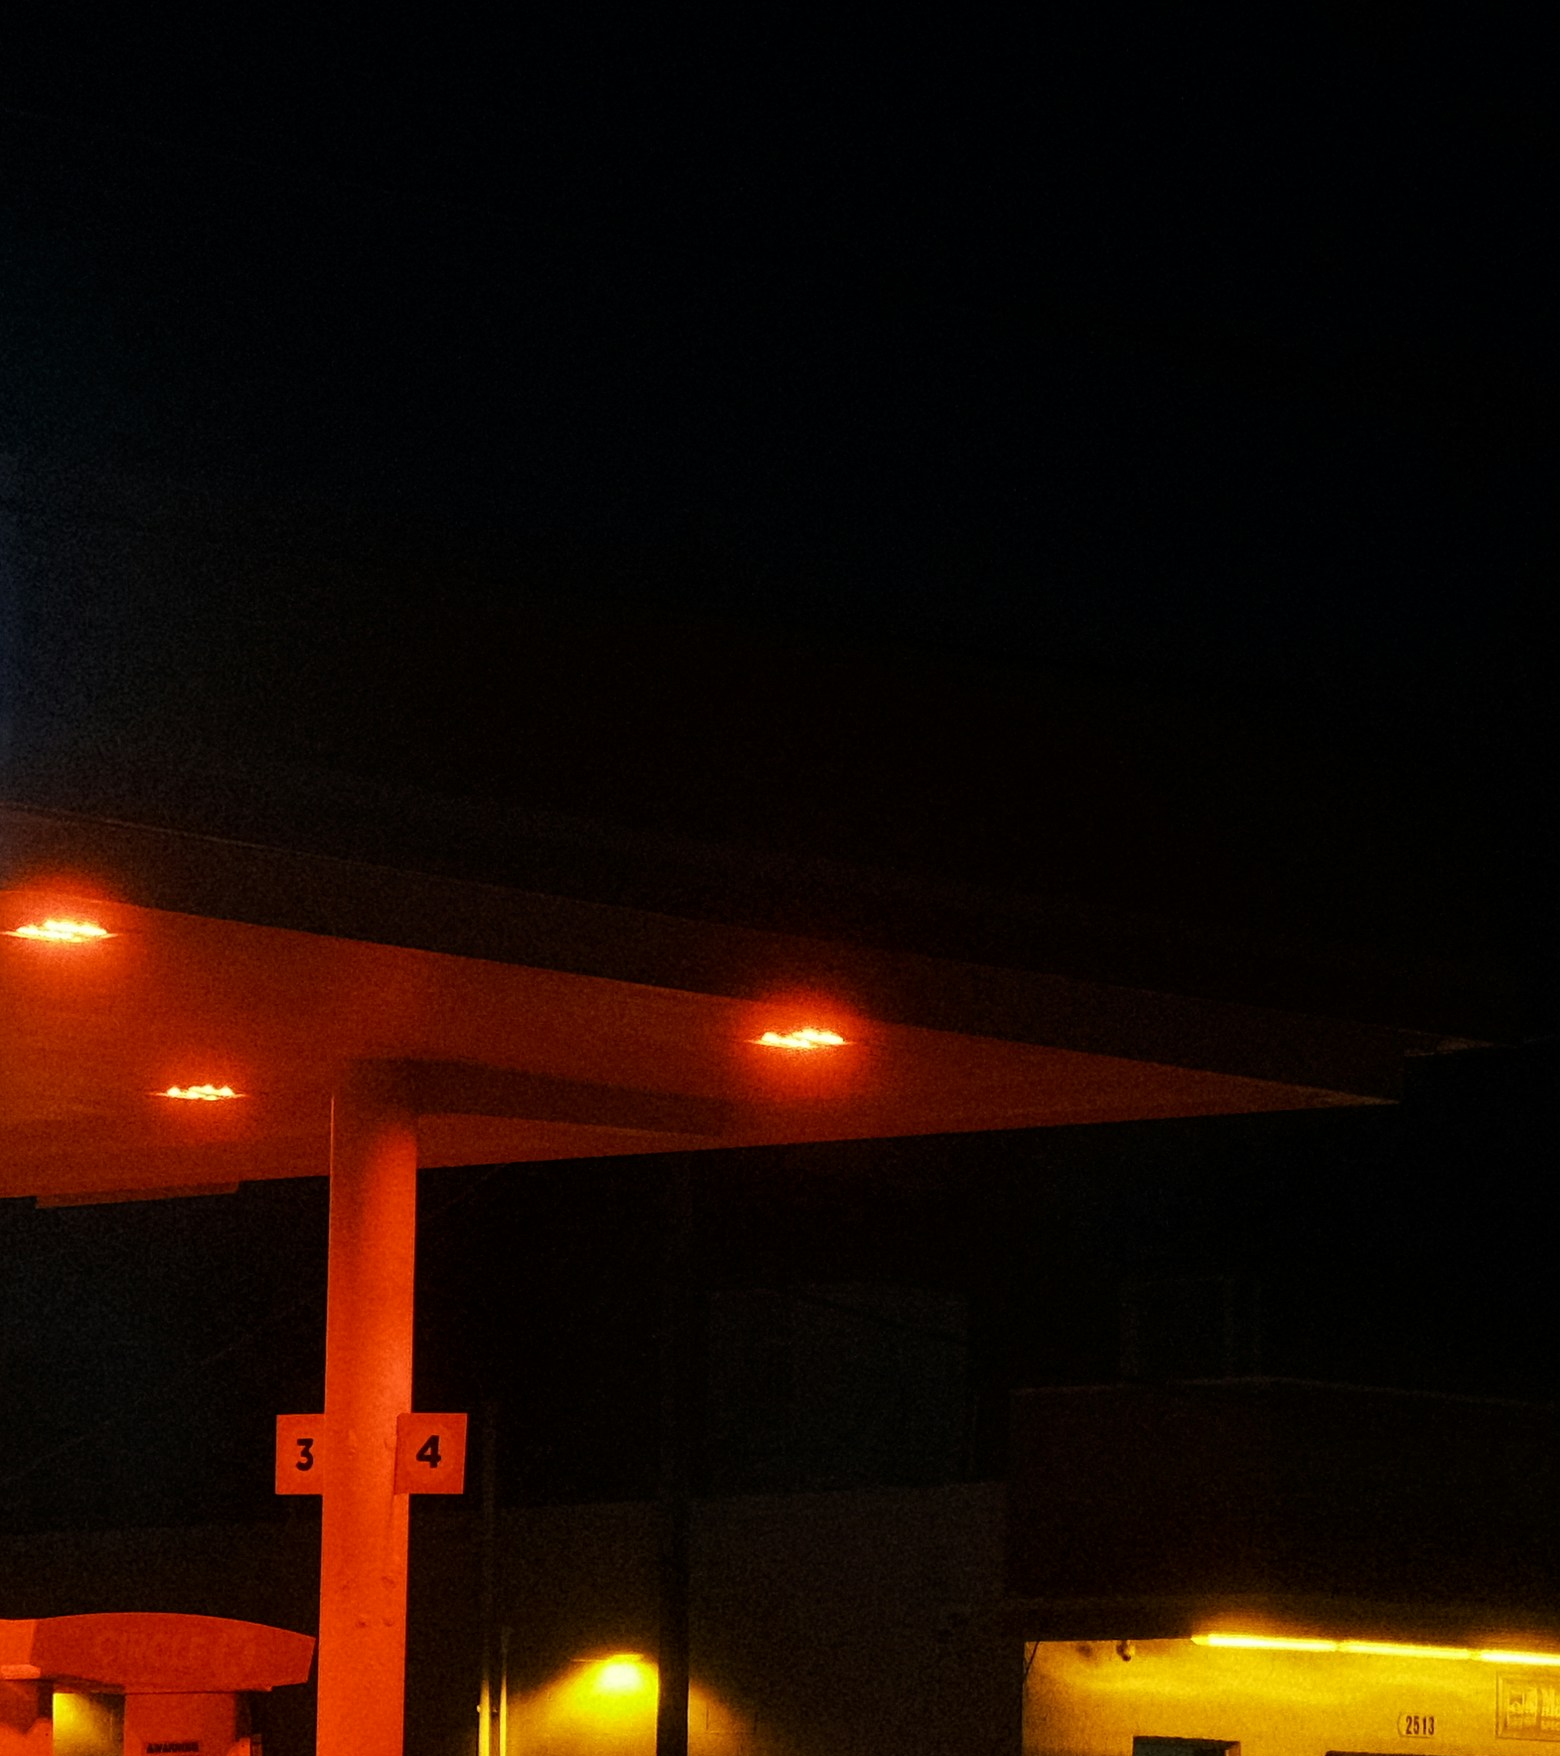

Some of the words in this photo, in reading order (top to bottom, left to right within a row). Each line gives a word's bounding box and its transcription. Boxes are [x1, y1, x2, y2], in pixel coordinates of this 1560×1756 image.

[295, 1437, 314, 1471] 3
[415, 1434, 442, 1469] 4
[1405, 1715, 1435, 1736] 2513
